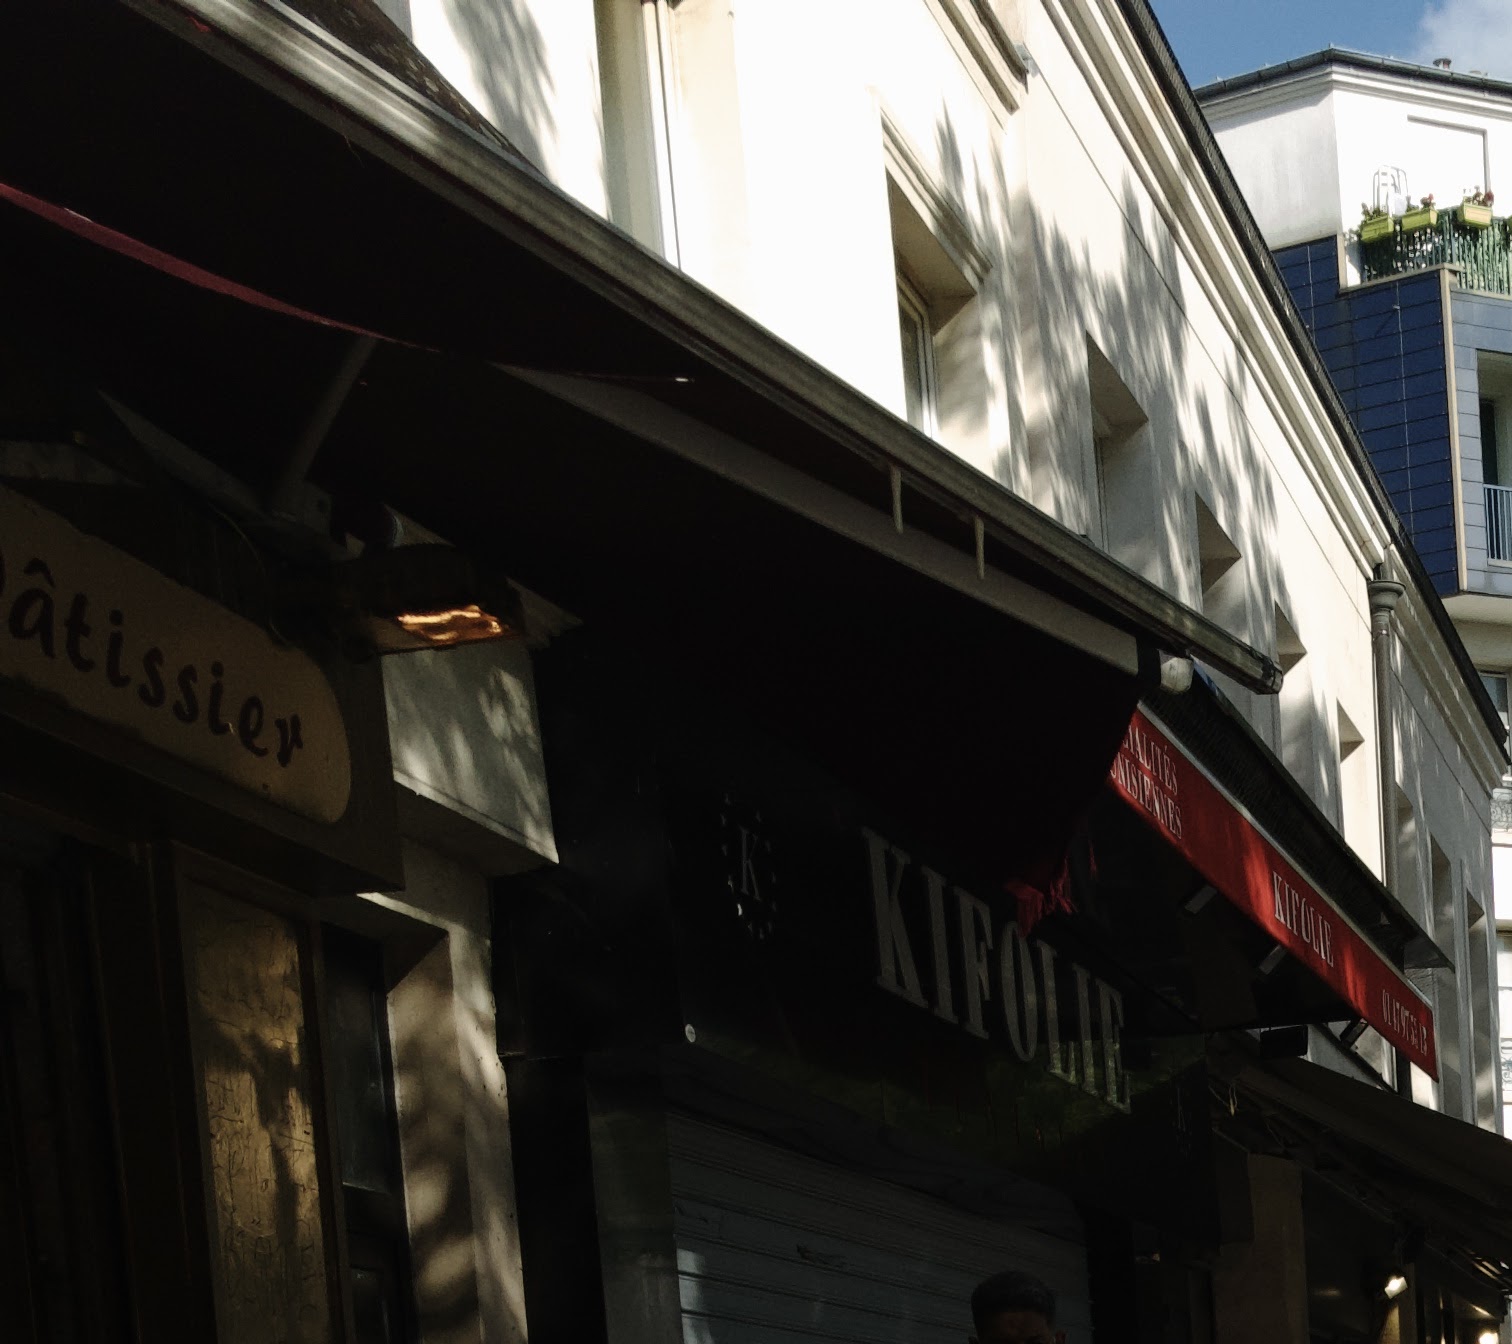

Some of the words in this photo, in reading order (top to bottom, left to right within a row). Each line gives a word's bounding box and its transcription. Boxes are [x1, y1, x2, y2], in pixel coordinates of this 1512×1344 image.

[0, 555, 304, 768] âtissier
[859, 825, 1132, 1115] KIFOLIE
[1272, 870, 1334, 968] KIFOLIE
